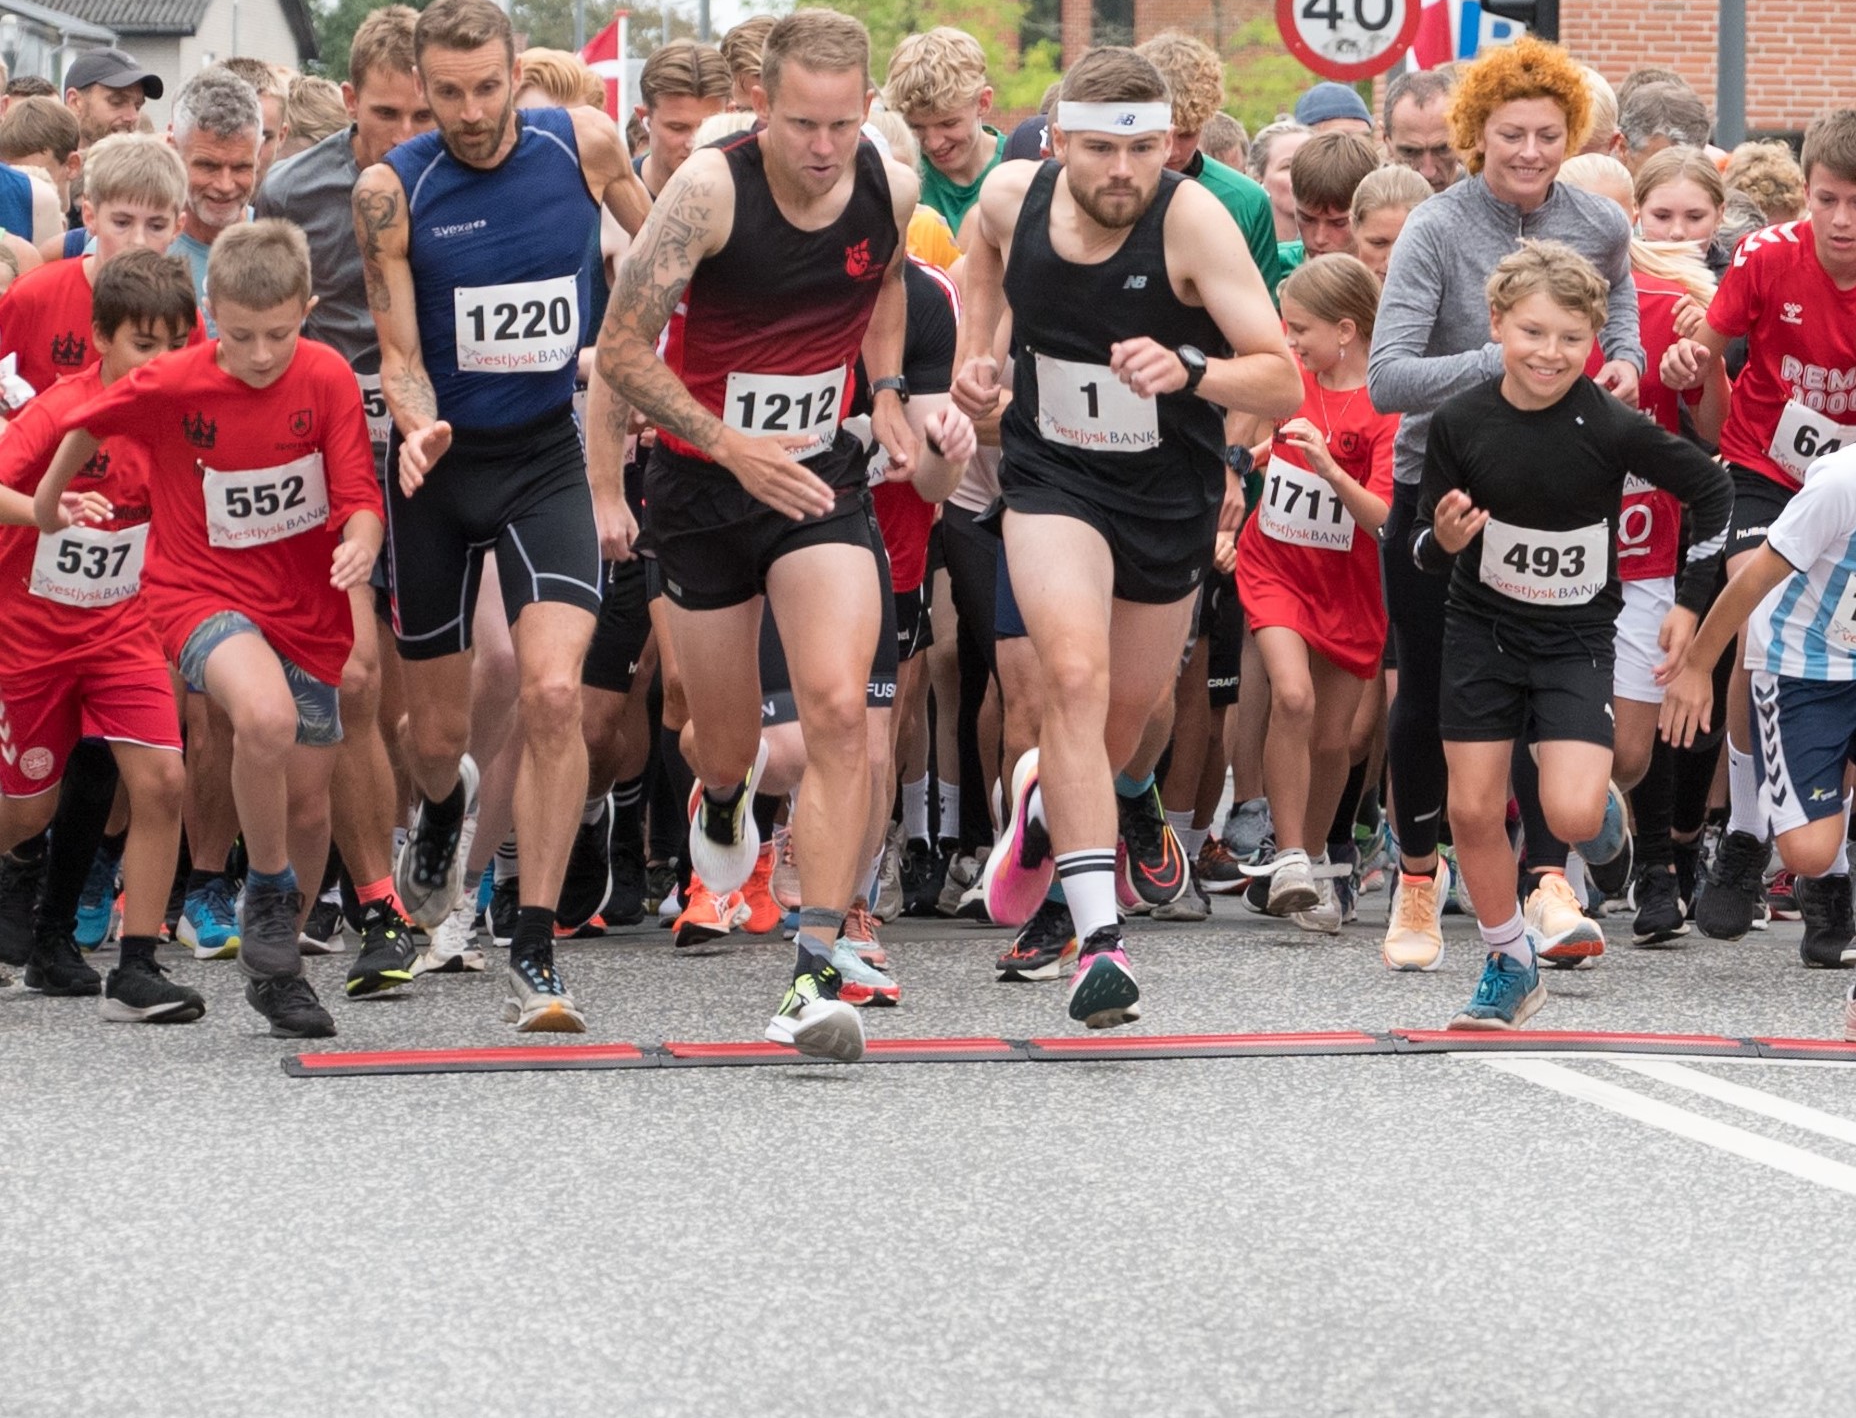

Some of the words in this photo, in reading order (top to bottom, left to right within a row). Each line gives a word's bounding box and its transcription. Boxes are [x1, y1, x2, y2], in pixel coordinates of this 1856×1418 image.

[466, 296, 571, 342] 1220
[736, 385, 837, 431] 1212
[1079, 381, 1099, 418] 1
[225, 475, 306, 518] 552
[1269, 475, 1344, 524] 1711
[57, 539, 131, 579] 537
[1503, 543, 1586, 577] 493
